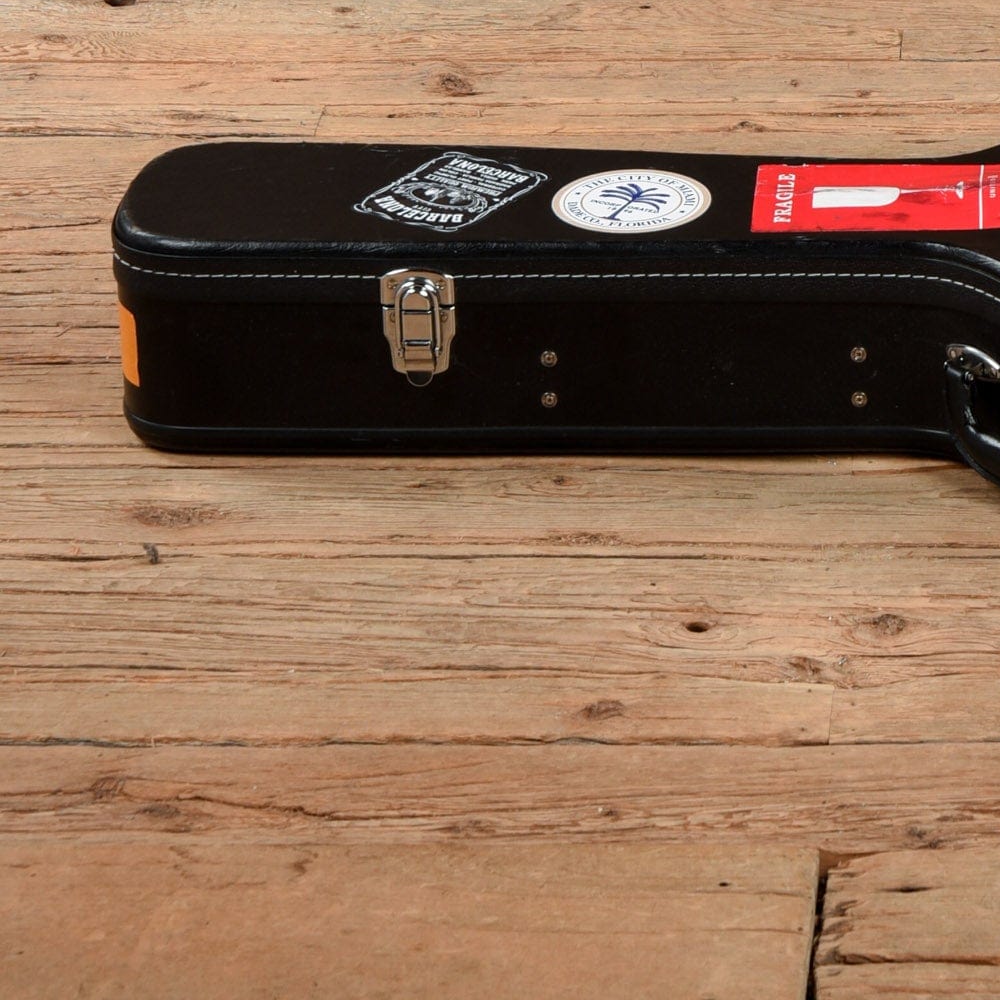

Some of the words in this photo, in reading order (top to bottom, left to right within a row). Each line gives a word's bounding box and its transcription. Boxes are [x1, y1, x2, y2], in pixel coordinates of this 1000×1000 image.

[450, 157, 530, 183] BARCELONA
[582, 176, 614, 189] THE
[658, 178, 679, 186] OF
[675, 184, 697, 207] MIAMI
[773, 173, 797, 223] FRAGILE
[374, 195, 464, 223] BARCELONA
[608, 217, 672, 228] FLORIDA
